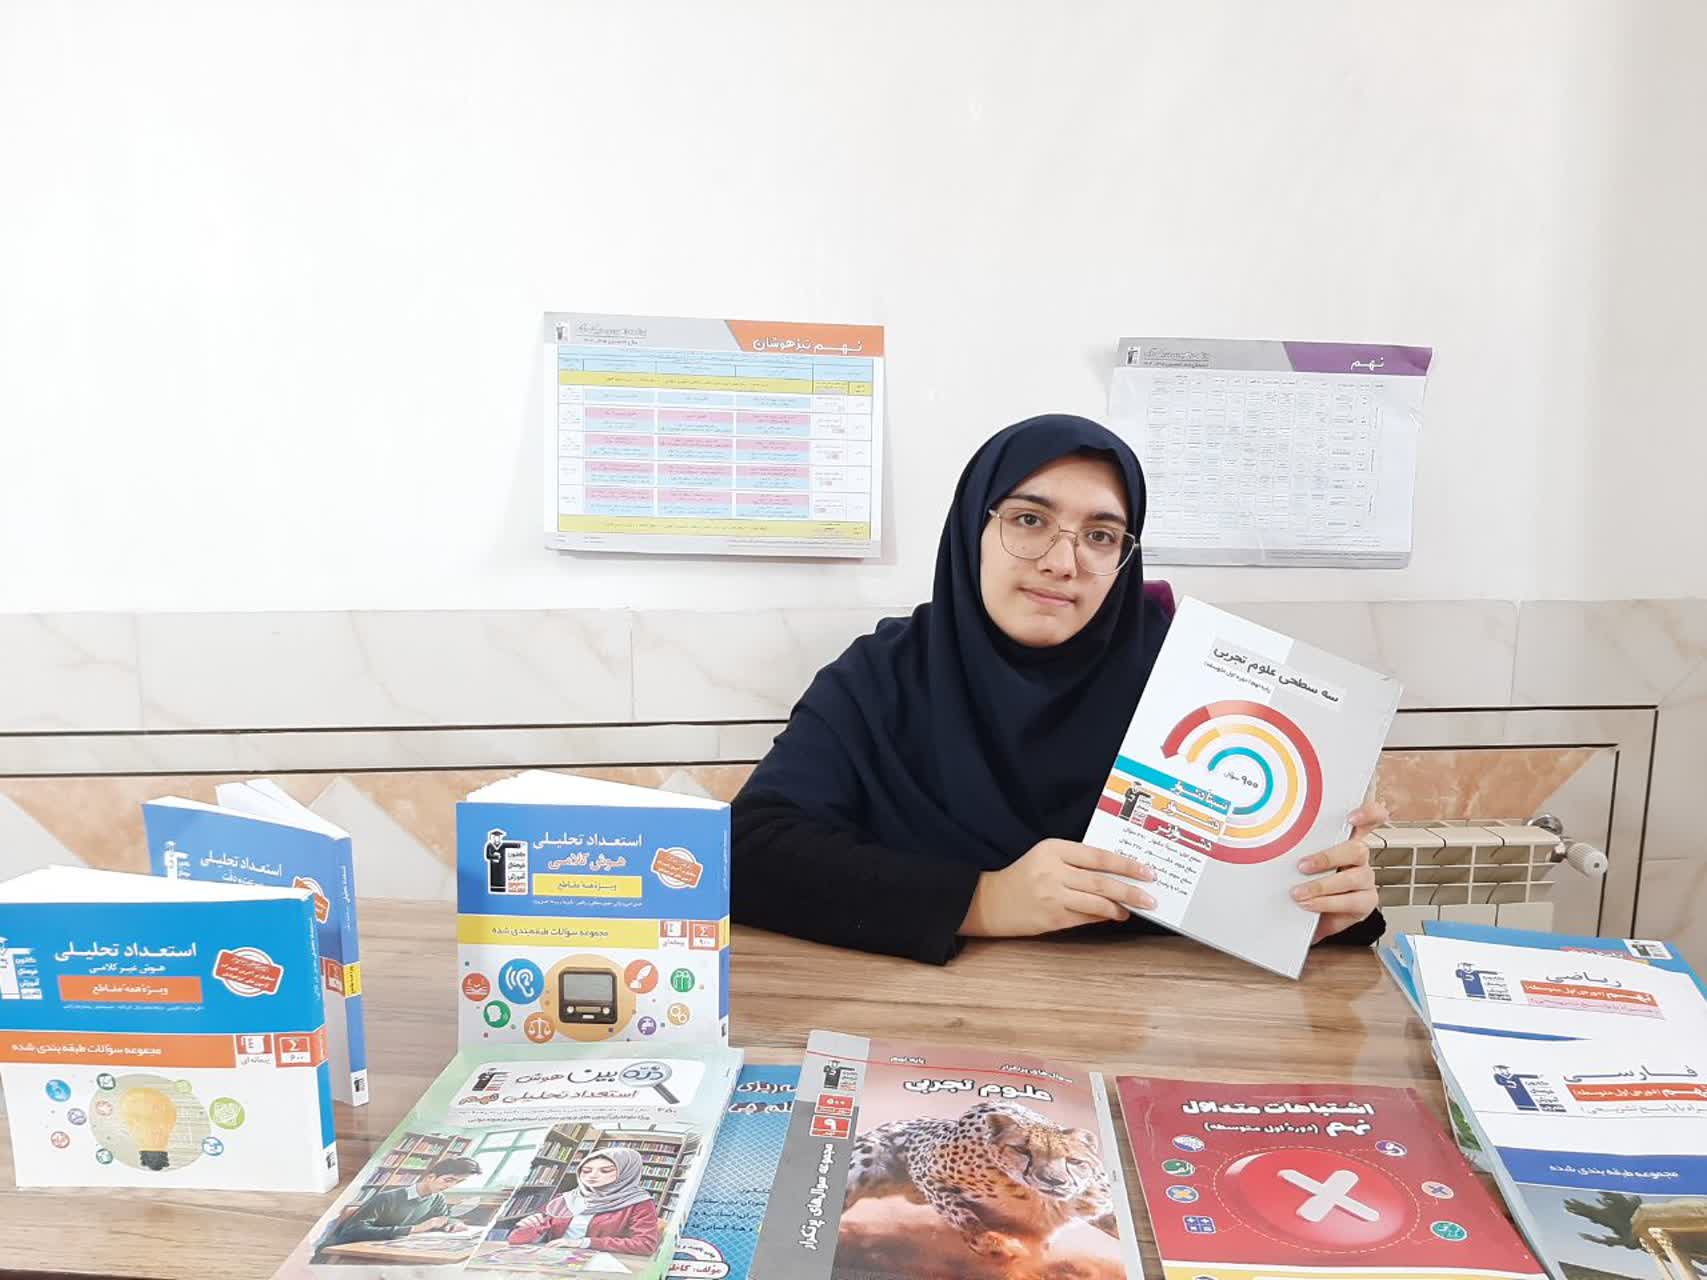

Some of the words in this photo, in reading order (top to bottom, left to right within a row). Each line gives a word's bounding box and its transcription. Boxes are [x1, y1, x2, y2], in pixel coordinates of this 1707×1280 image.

[752, 336, 811, 350] تیزهوشان
[814, 340, 862, 354] نهم
[1350, 356, 1384, 370] نهم
[1213, 648, 1248, 665] تجربی
[1247, 661, 1276, 677] علوم
[1278, 675, 1318, 694] سطحی
[1320, 689, 1339, 702] سه
[533, 832, 584, 849] تحلیلی
[586, 833, 642, 847] استعداد
[200, 850, 240, 868] تحلیلی
[548, 851, 590, 870] کلامی
[589, 852, 627, 871] هوش
[240, 857, 282, 877] استعداد
[54, 942, 119, 961] تحلیلی
[124, 942, 197, 957] استعداد
[88, 963, 118, 974] کلامی
[1546, 971, 1622, 988] ریاضی
[124, 1047, 162, 1056] مجموعه
[516, 1073, 564, 1083] هوش
[568, 1068, 618, 1083] بین
[1563, 1065, 1698, 1083] فارسی
[569, 1090, 638, 1098] استعداد
[904, 1079, 975, 1094] تجربی
[979, 1084, 1053, 1101] علوم
[503, 1091, 569, 1103] تحلیلی
[1182, 1100, 1261, 1114] متداول
[1264, 1101, 1375, 1117] اشتباهات
[1326, 1119, 1371, 1136] نهم
[1635, 1170, 1679, 1179] مجموعه
[799, 1219, 826, 1250] پرتکرار
